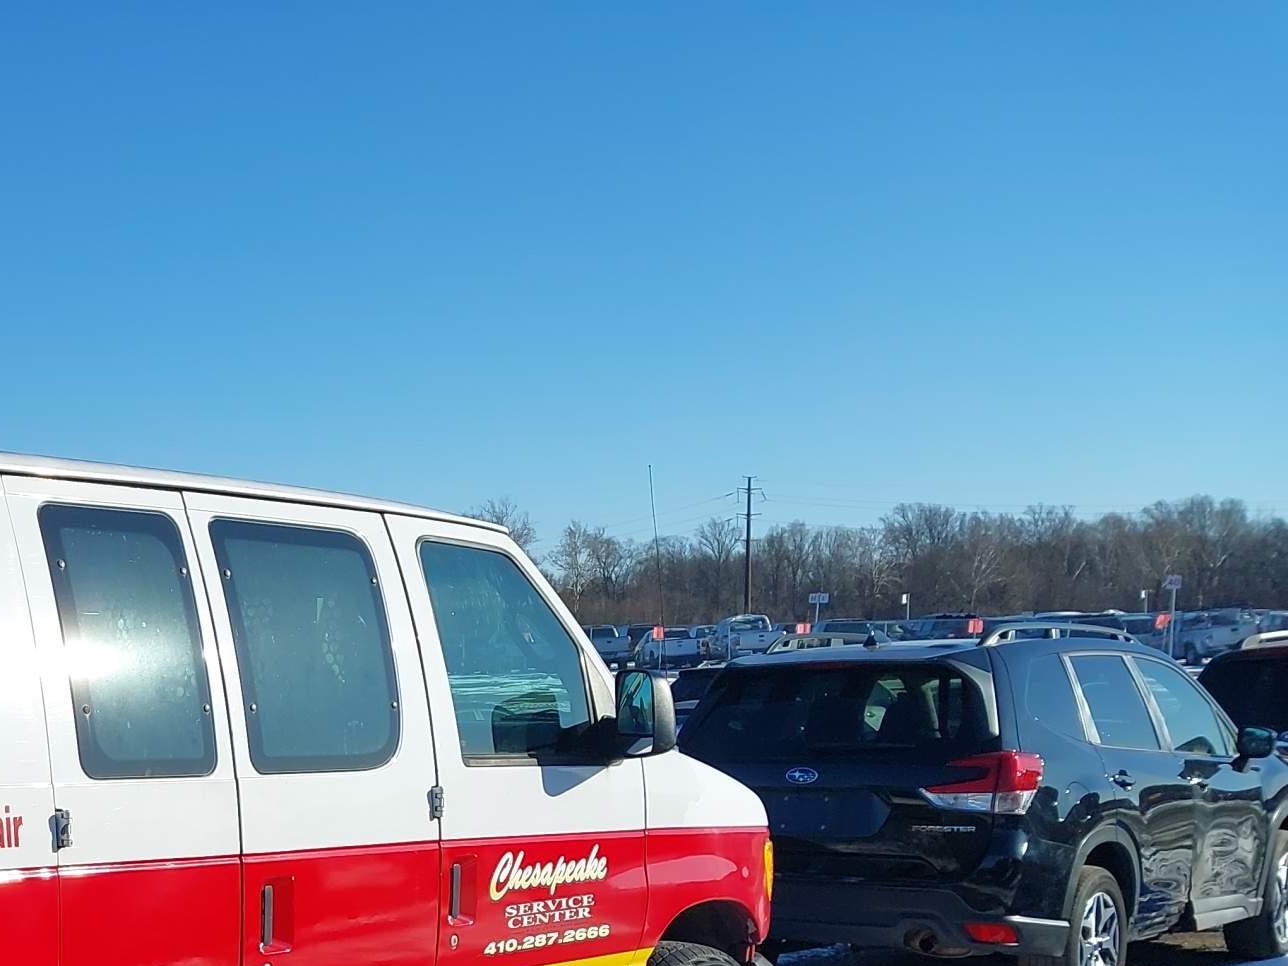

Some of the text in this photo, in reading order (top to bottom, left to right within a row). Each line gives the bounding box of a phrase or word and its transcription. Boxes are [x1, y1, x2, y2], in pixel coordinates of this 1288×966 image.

[490, 843, 607, 901] Chesapeake
[505, 894, 595, 917] SERVICE
[507, 907, 592, 929] CENTER
[483, 924, 610, 956] 410.287.2666
